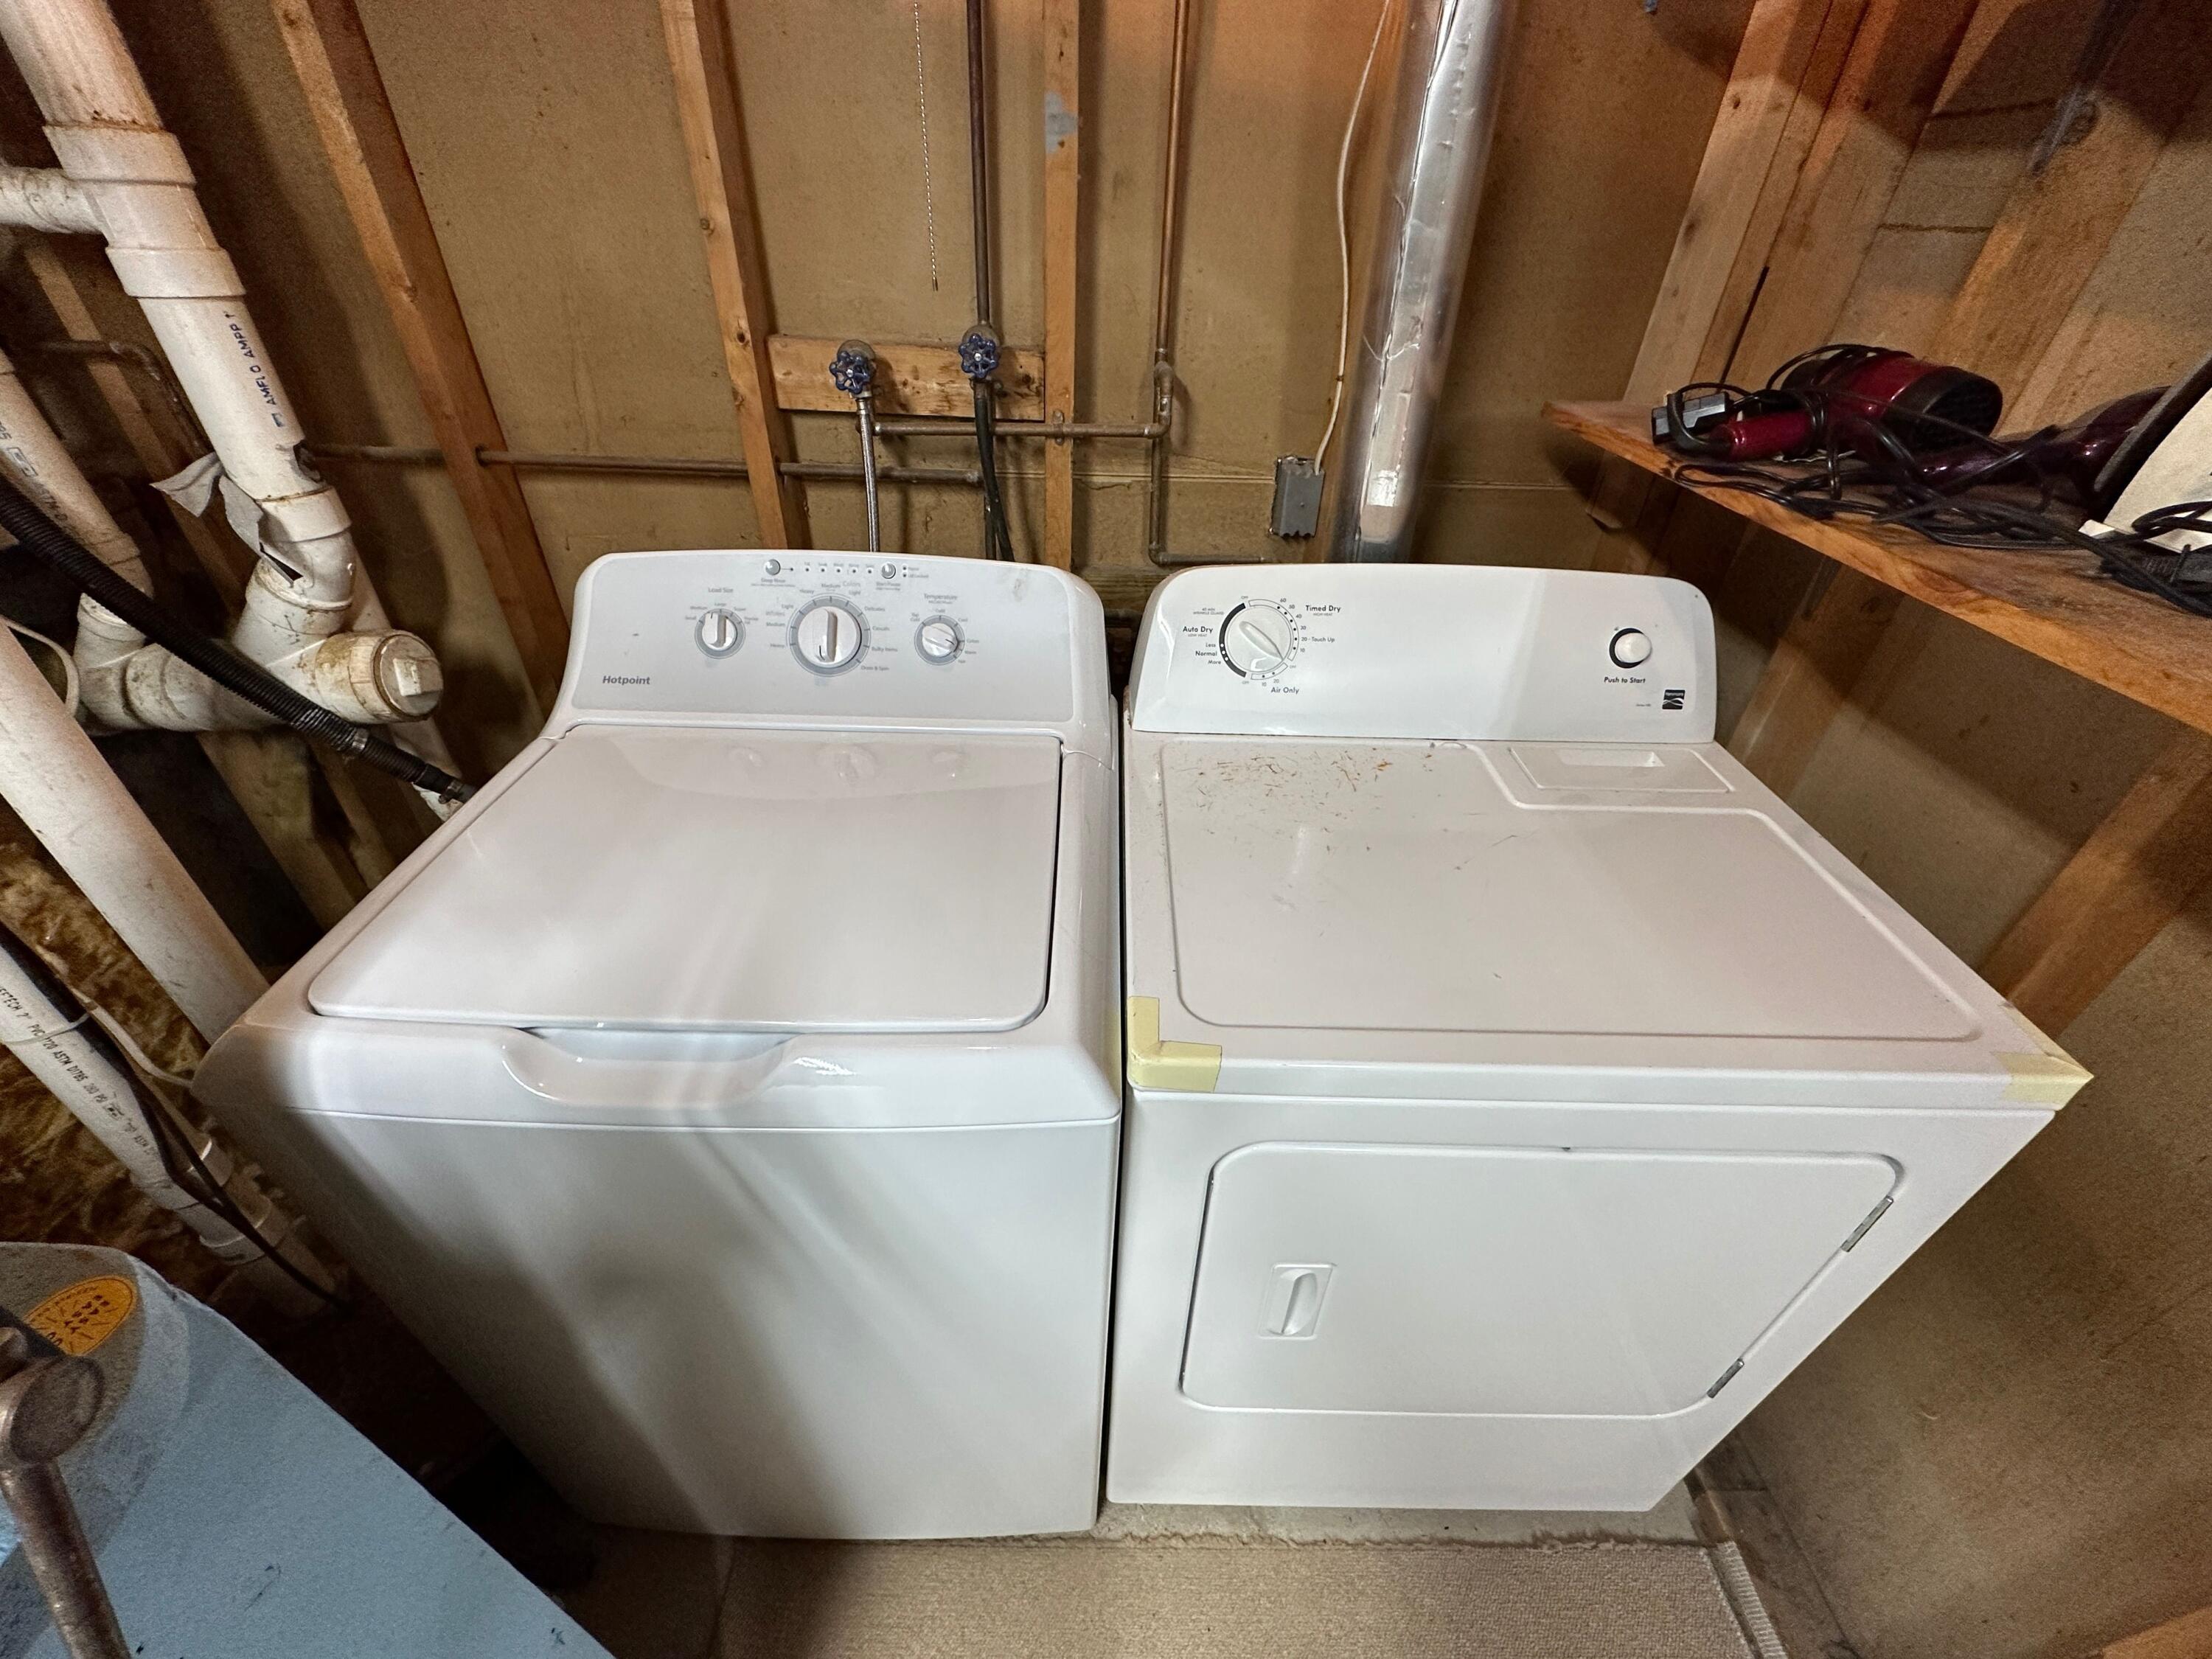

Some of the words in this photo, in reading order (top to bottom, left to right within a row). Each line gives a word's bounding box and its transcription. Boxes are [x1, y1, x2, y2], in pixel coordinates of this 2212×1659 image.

[1328, 605, 1341, 613] Dry
[602, 675, 651, 686] Hotpoint
[1282, 686, 1299, 695] Only
[27, 1023, 46, 1037] PVC
[52, 1050, 73, 1066] ASTM
